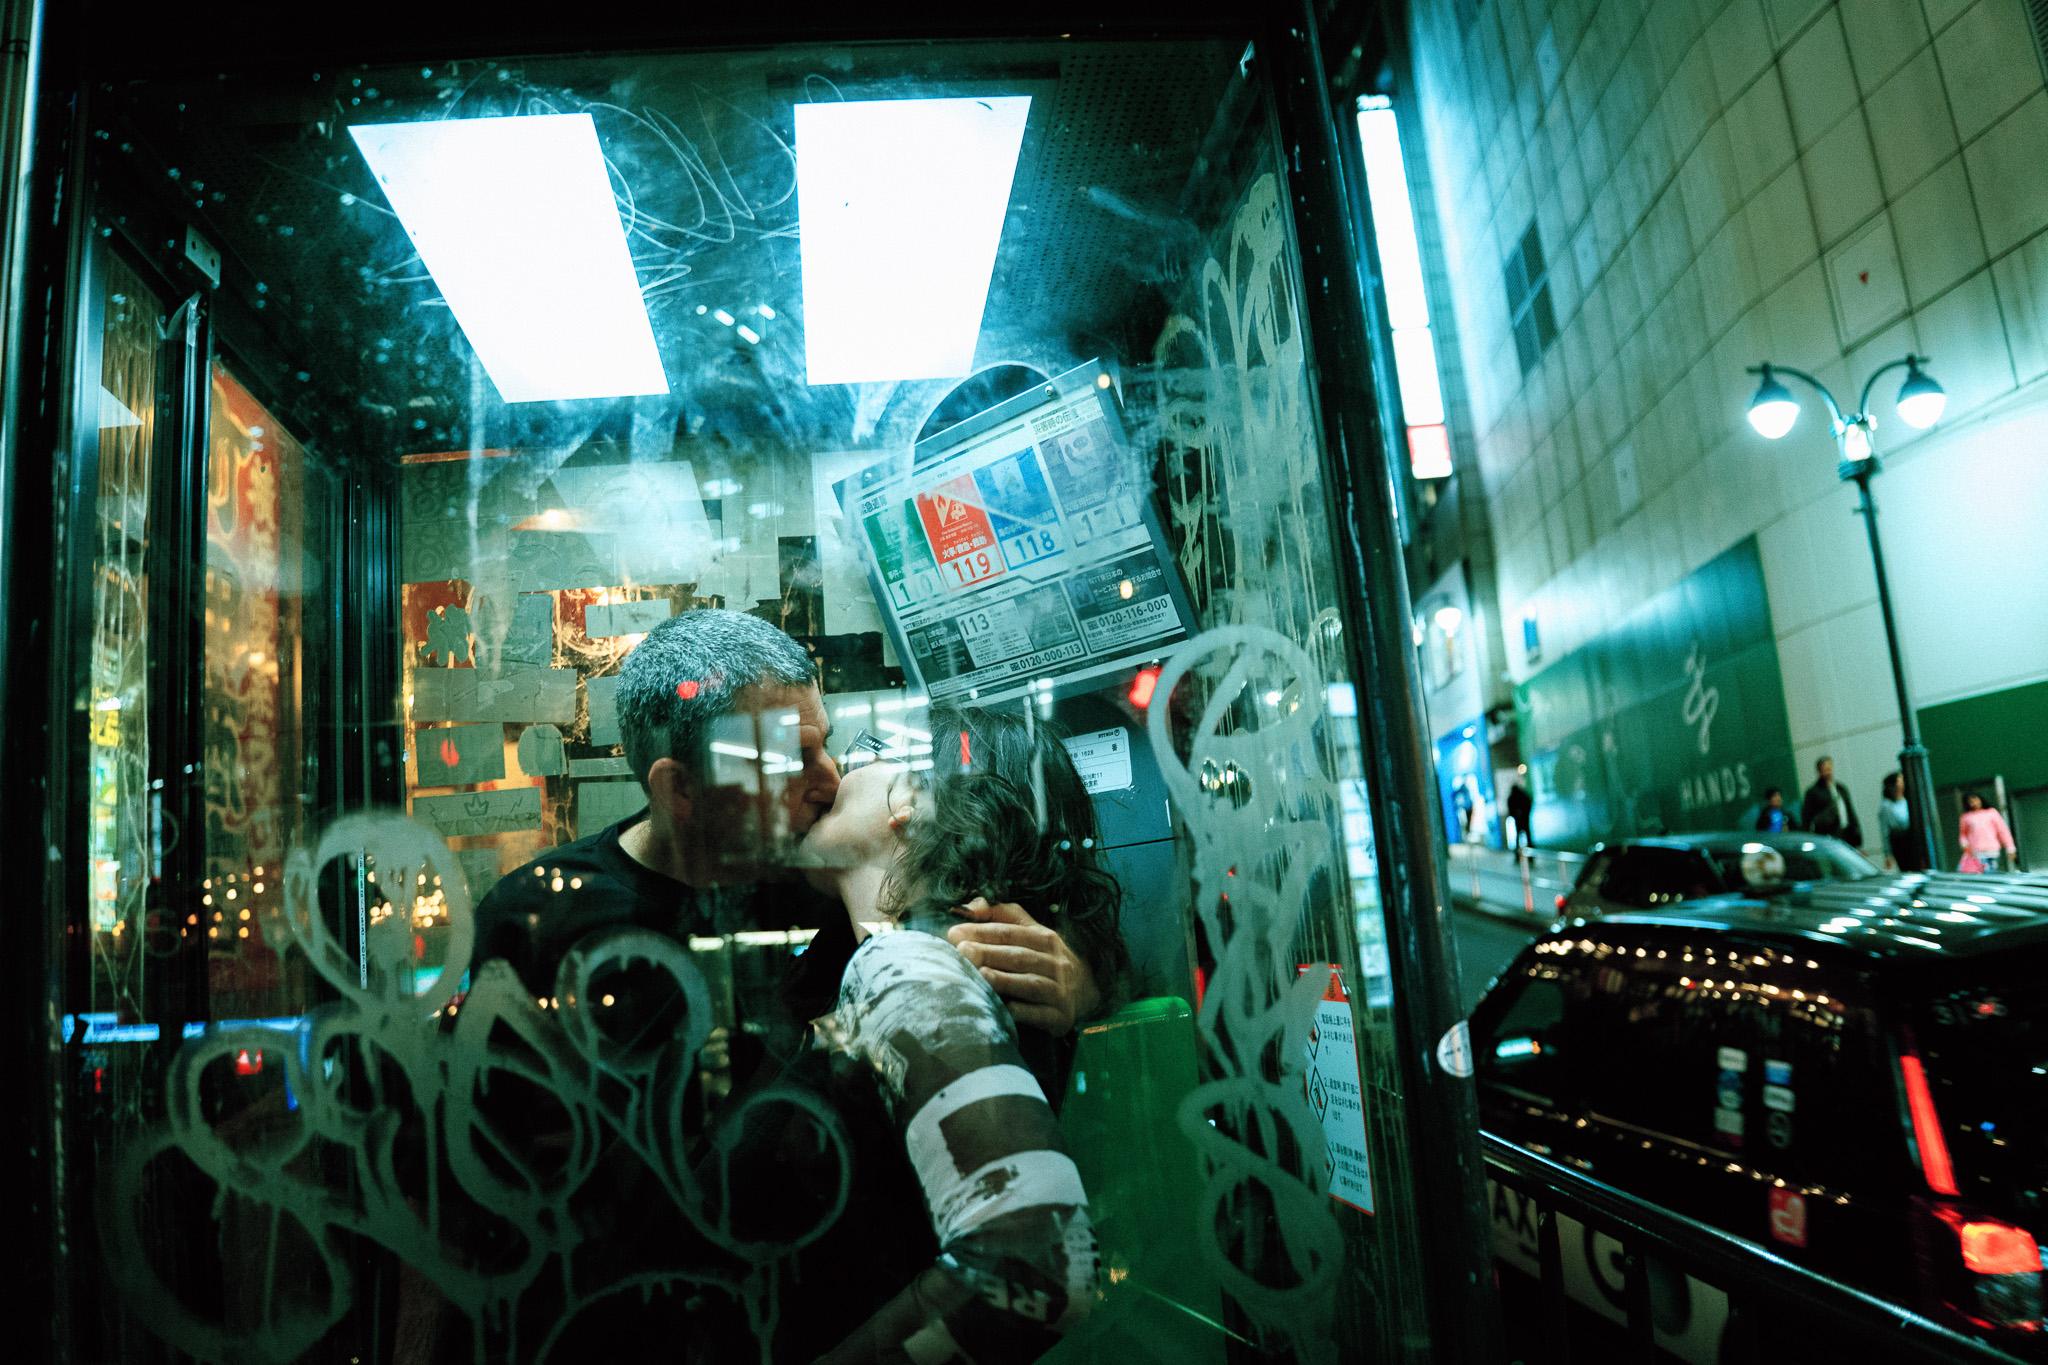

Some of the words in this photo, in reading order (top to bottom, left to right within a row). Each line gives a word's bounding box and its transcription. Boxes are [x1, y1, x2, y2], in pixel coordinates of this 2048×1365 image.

[1015, 530, 1055, 560] 118
[953, 552, 991, 582] 119
[960, 613, 990, 636] 113
[1098, 597, 1169, 628] 0120-116-000
[1020, 643, 1081, 669] 0120-000-113
[1680, 762, 1751, 812] HANDS
